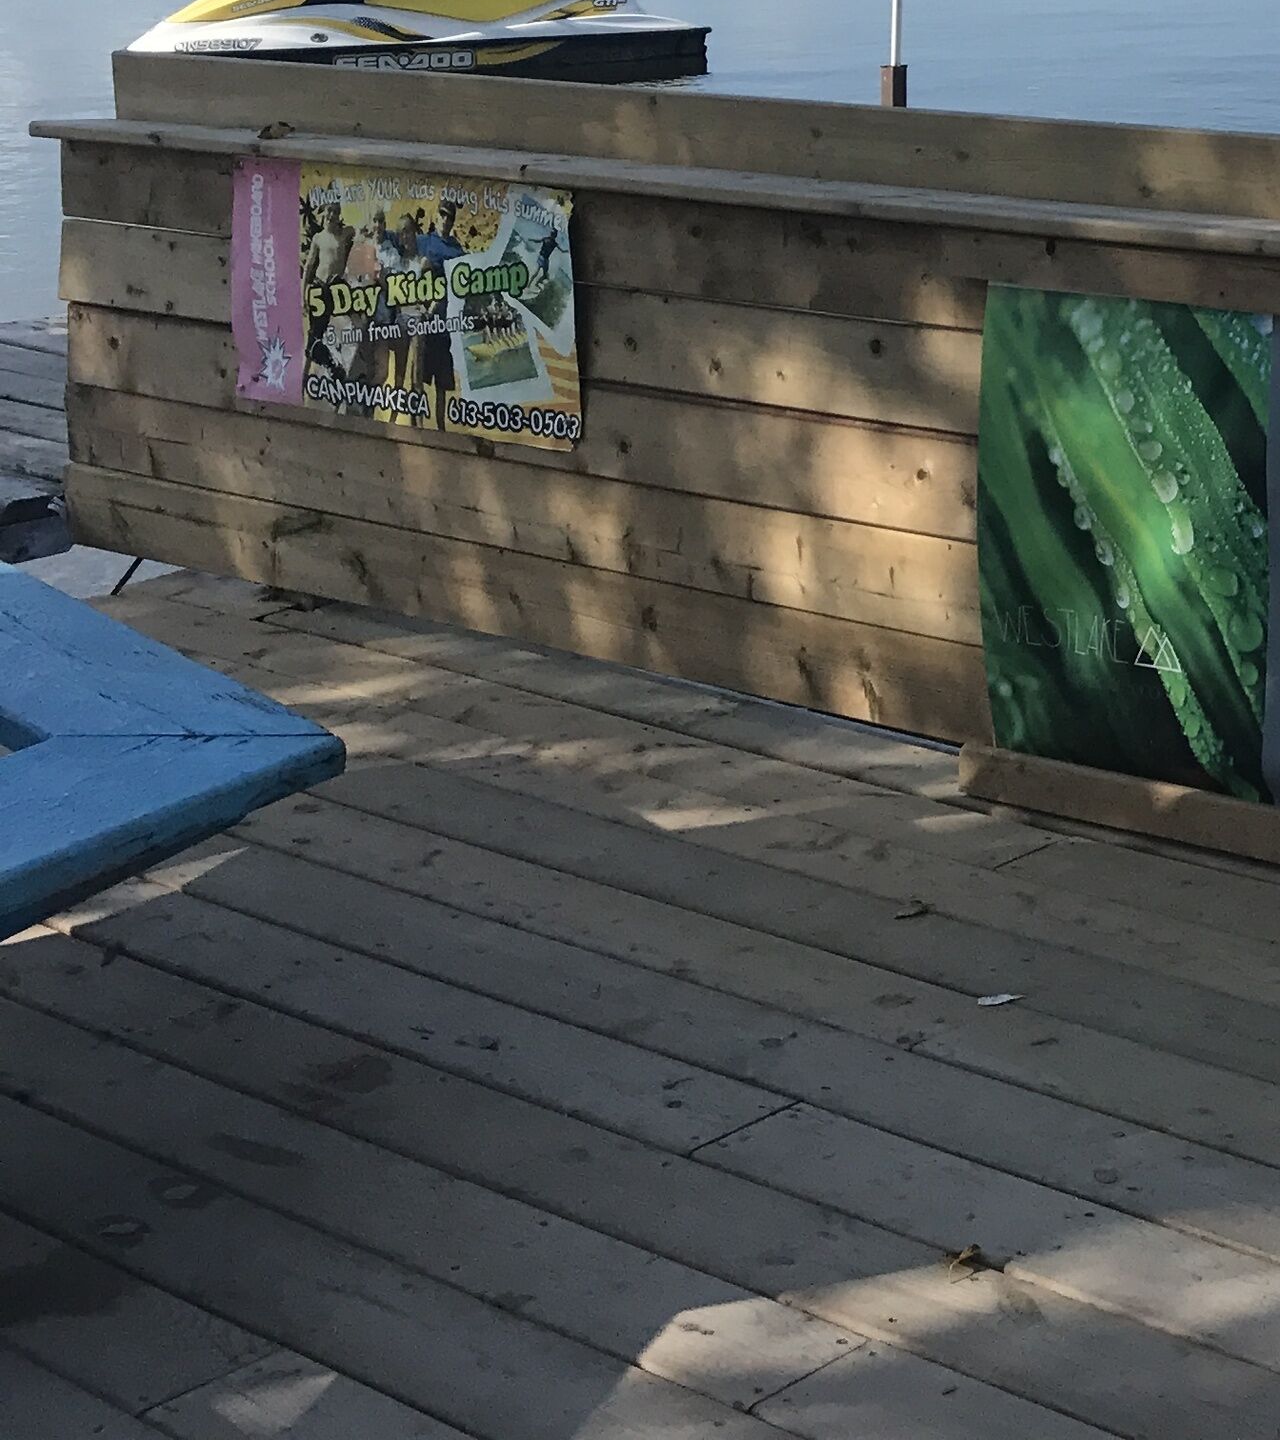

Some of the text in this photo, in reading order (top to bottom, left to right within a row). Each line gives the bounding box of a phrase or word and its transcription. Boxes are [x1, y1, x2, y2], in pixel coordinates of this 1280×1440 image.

[250, 173, 264, 264] WAKEBOARD
[309, 180, 341, 208] What
[368, 179, 401, 201] YOUR
[440, 179, 478, 215] doing
[483, 186, 509, 214] this
[263, 235, 277, 306] SCHOOL
[308, 262, 529, 317] 5 Day Kids Camp
[326, 314, 475, 345] 5 min from Sandbanks
[448, 397, 581, 440] 613-503-0503
[993, 603, 1129, 664] WESTLAKE
